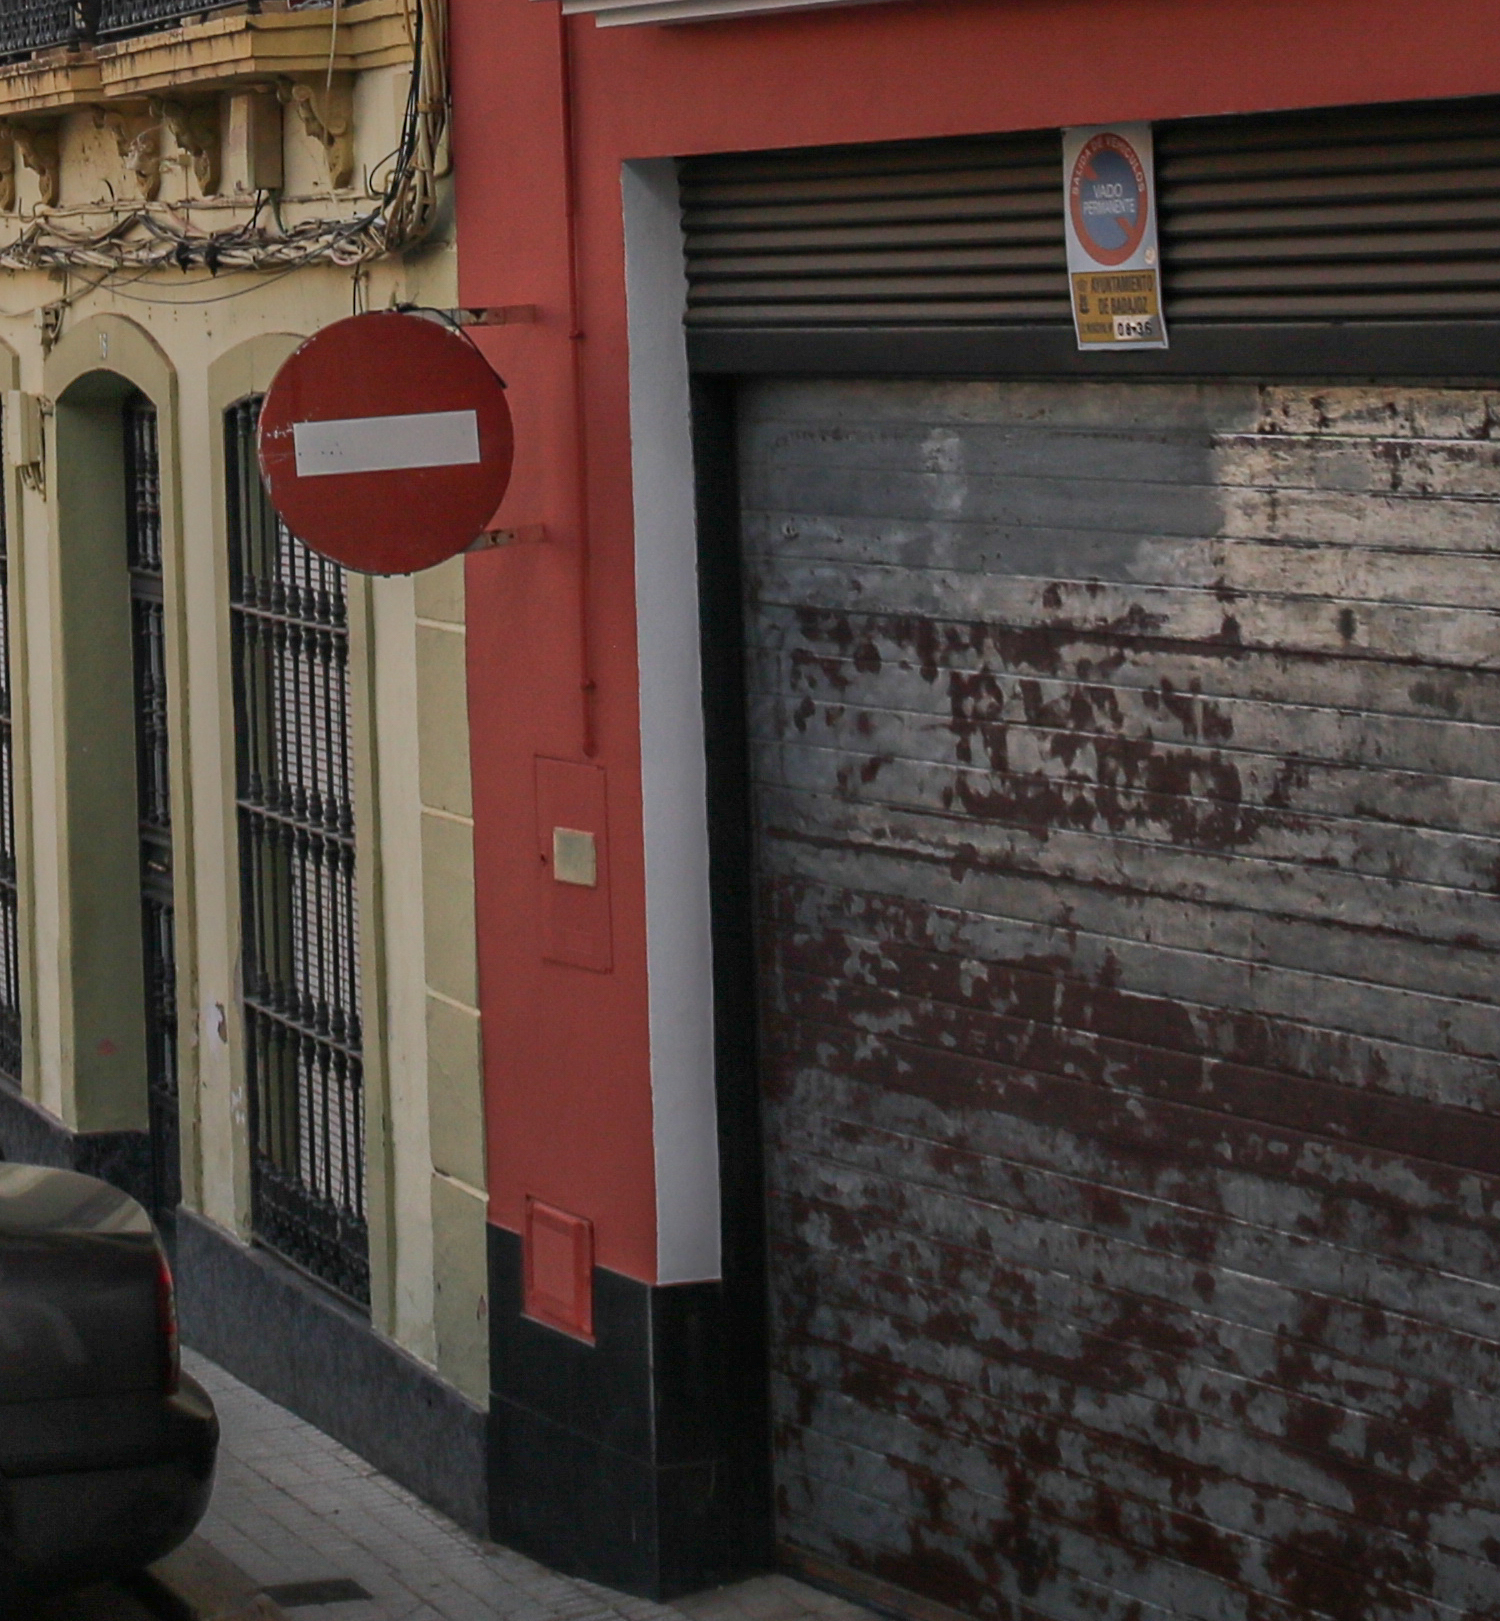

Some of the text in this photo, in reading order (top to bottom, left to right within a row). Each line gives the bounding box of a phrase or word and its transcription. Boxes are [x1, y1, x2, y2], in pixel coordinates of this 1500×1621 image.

[1092, 182, 1124, 199] VADO
[1083, 198, 1136, 216] PERMANENTE
[1098, 297, 1110, 315] DE
